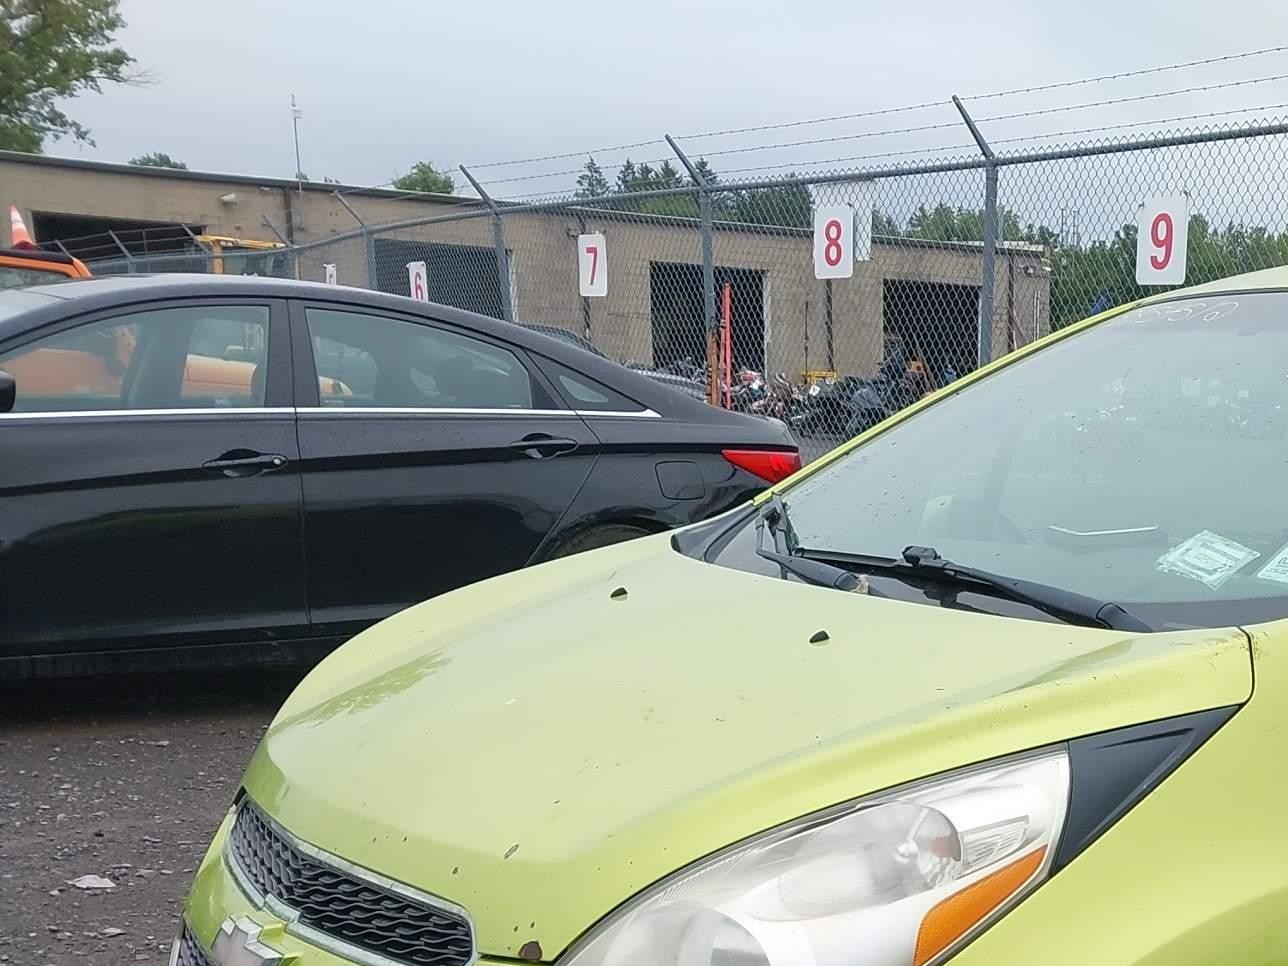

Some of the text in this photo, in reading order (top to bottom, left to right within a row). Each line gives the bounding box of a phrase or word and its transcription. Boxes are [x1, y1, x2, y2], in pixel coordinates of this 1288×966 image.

[824, 219, 842, 267] 8
[1150, 213, 1174, 270] 9
[586, 247, 598, 285] 7
